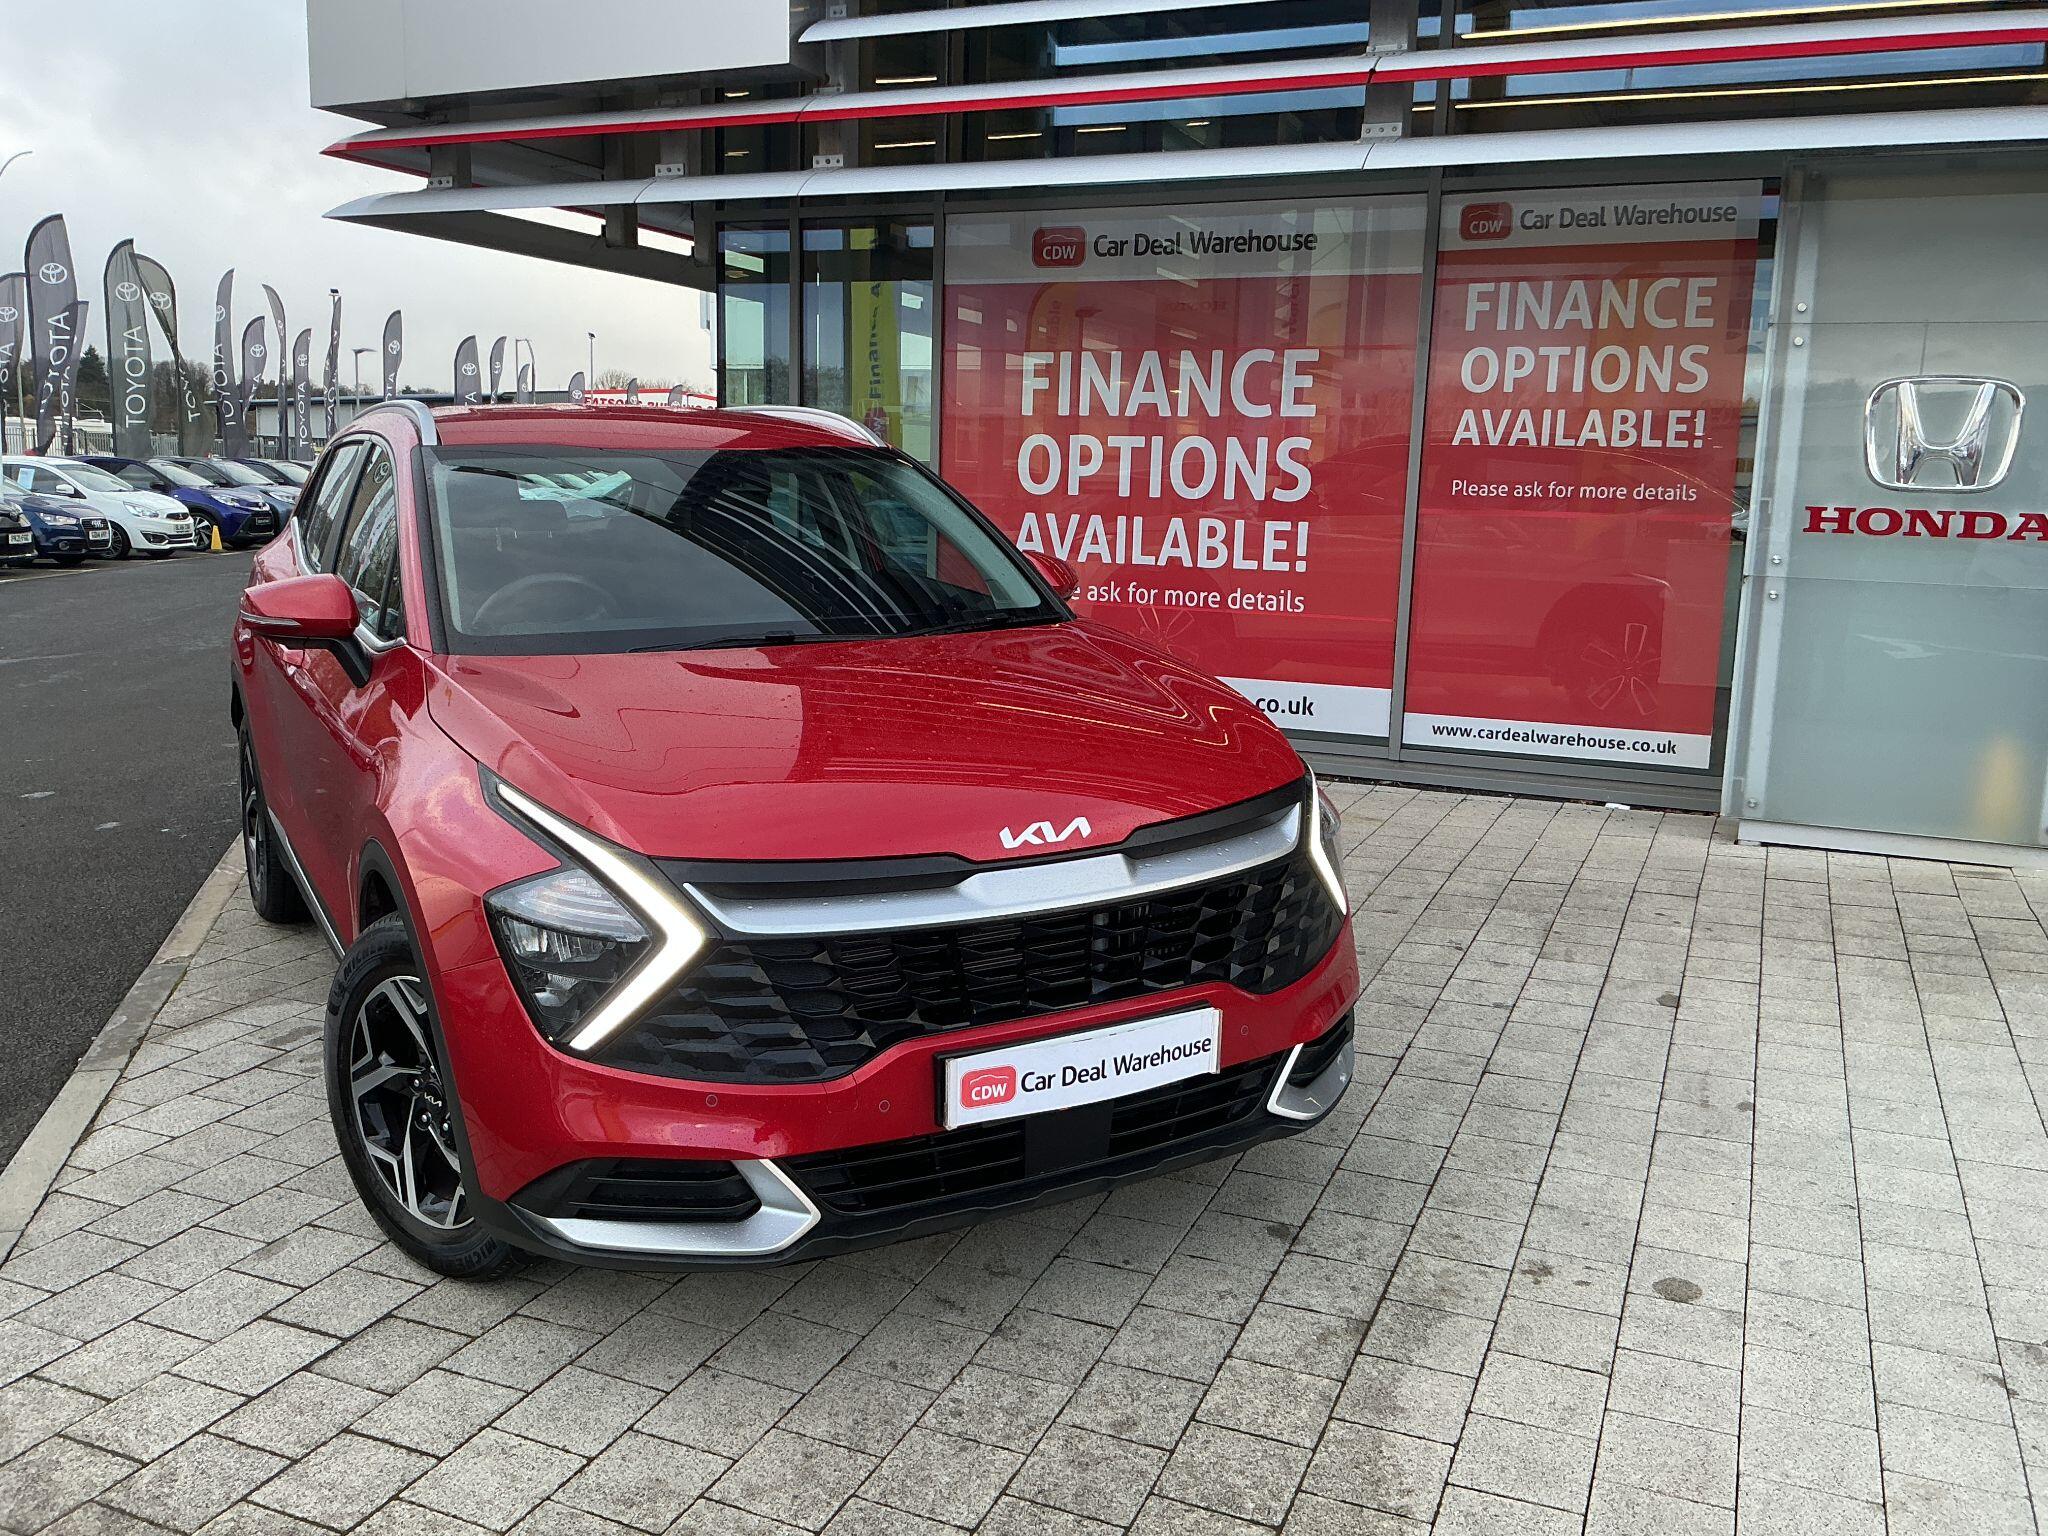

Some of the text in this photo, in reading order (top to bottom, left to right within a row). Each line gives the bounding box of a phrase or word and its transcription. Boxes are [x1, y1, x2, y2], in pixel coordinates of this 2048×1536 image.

[1469, 203, 1737, 234] CDW Car Deal Warehouse
[1042, 229, 1318, 260] CDW Car Deal Warehouse
[1465, 277, 1718, 331] FINANCE
[123, 325, 146, 428] TOYOTA
[868, 305, 883, 399] Finan
[1460, 345, 1710, 393] OPTIONS
[1021, 348, 1319, 418] FINANCE
[298, 381, 309, 448] TOYOTA
[1451, 408, 1706, 449] AVAILABLE!
[1017, 433, 1312, 502] OPTIONS
[1451, 480, 1697, 501] Please ask for more details
[1016, 512, 1309, 573] AVAILABLE!
[1802, 506, 2048, 541] HONDA
[1087, 581, 1121, 602] ask
[1127, 581, 1158, 605] for
[1164, 590, 1221, 608] more
[1228, 587, 1305, 613] details
[1432, 723, 1677, 755] www.cardealwarehouse.co.uk
[971, 1037, 1212, 1101] CDW Car Deal Warehouse
